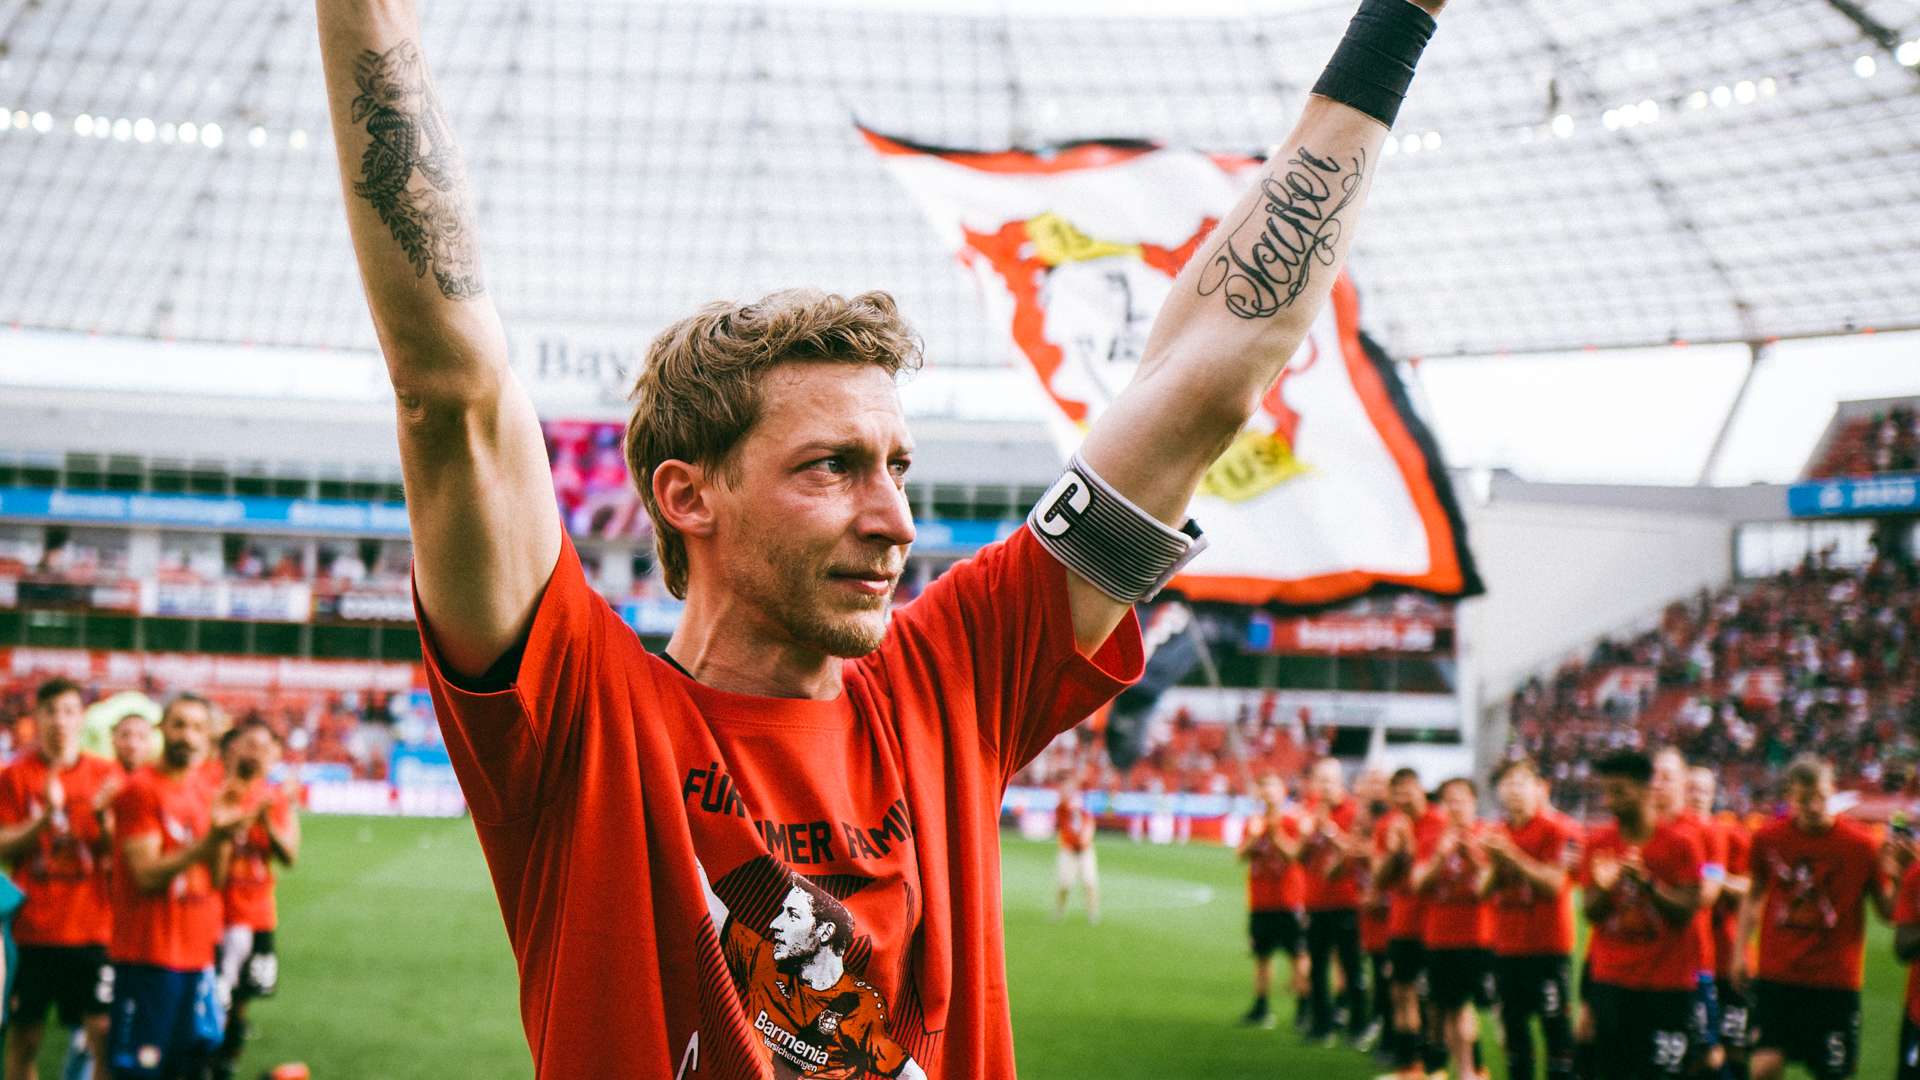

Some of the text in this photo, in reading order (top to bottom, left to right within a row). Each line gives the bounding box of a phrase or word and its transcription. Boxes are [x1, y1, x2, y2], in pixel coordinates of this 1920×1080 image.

[1036, 471, 1091, 536] C
[754, 1010, 829, 1065] Barmenia
[763, 1036, 818, 1072] Versicherungen
